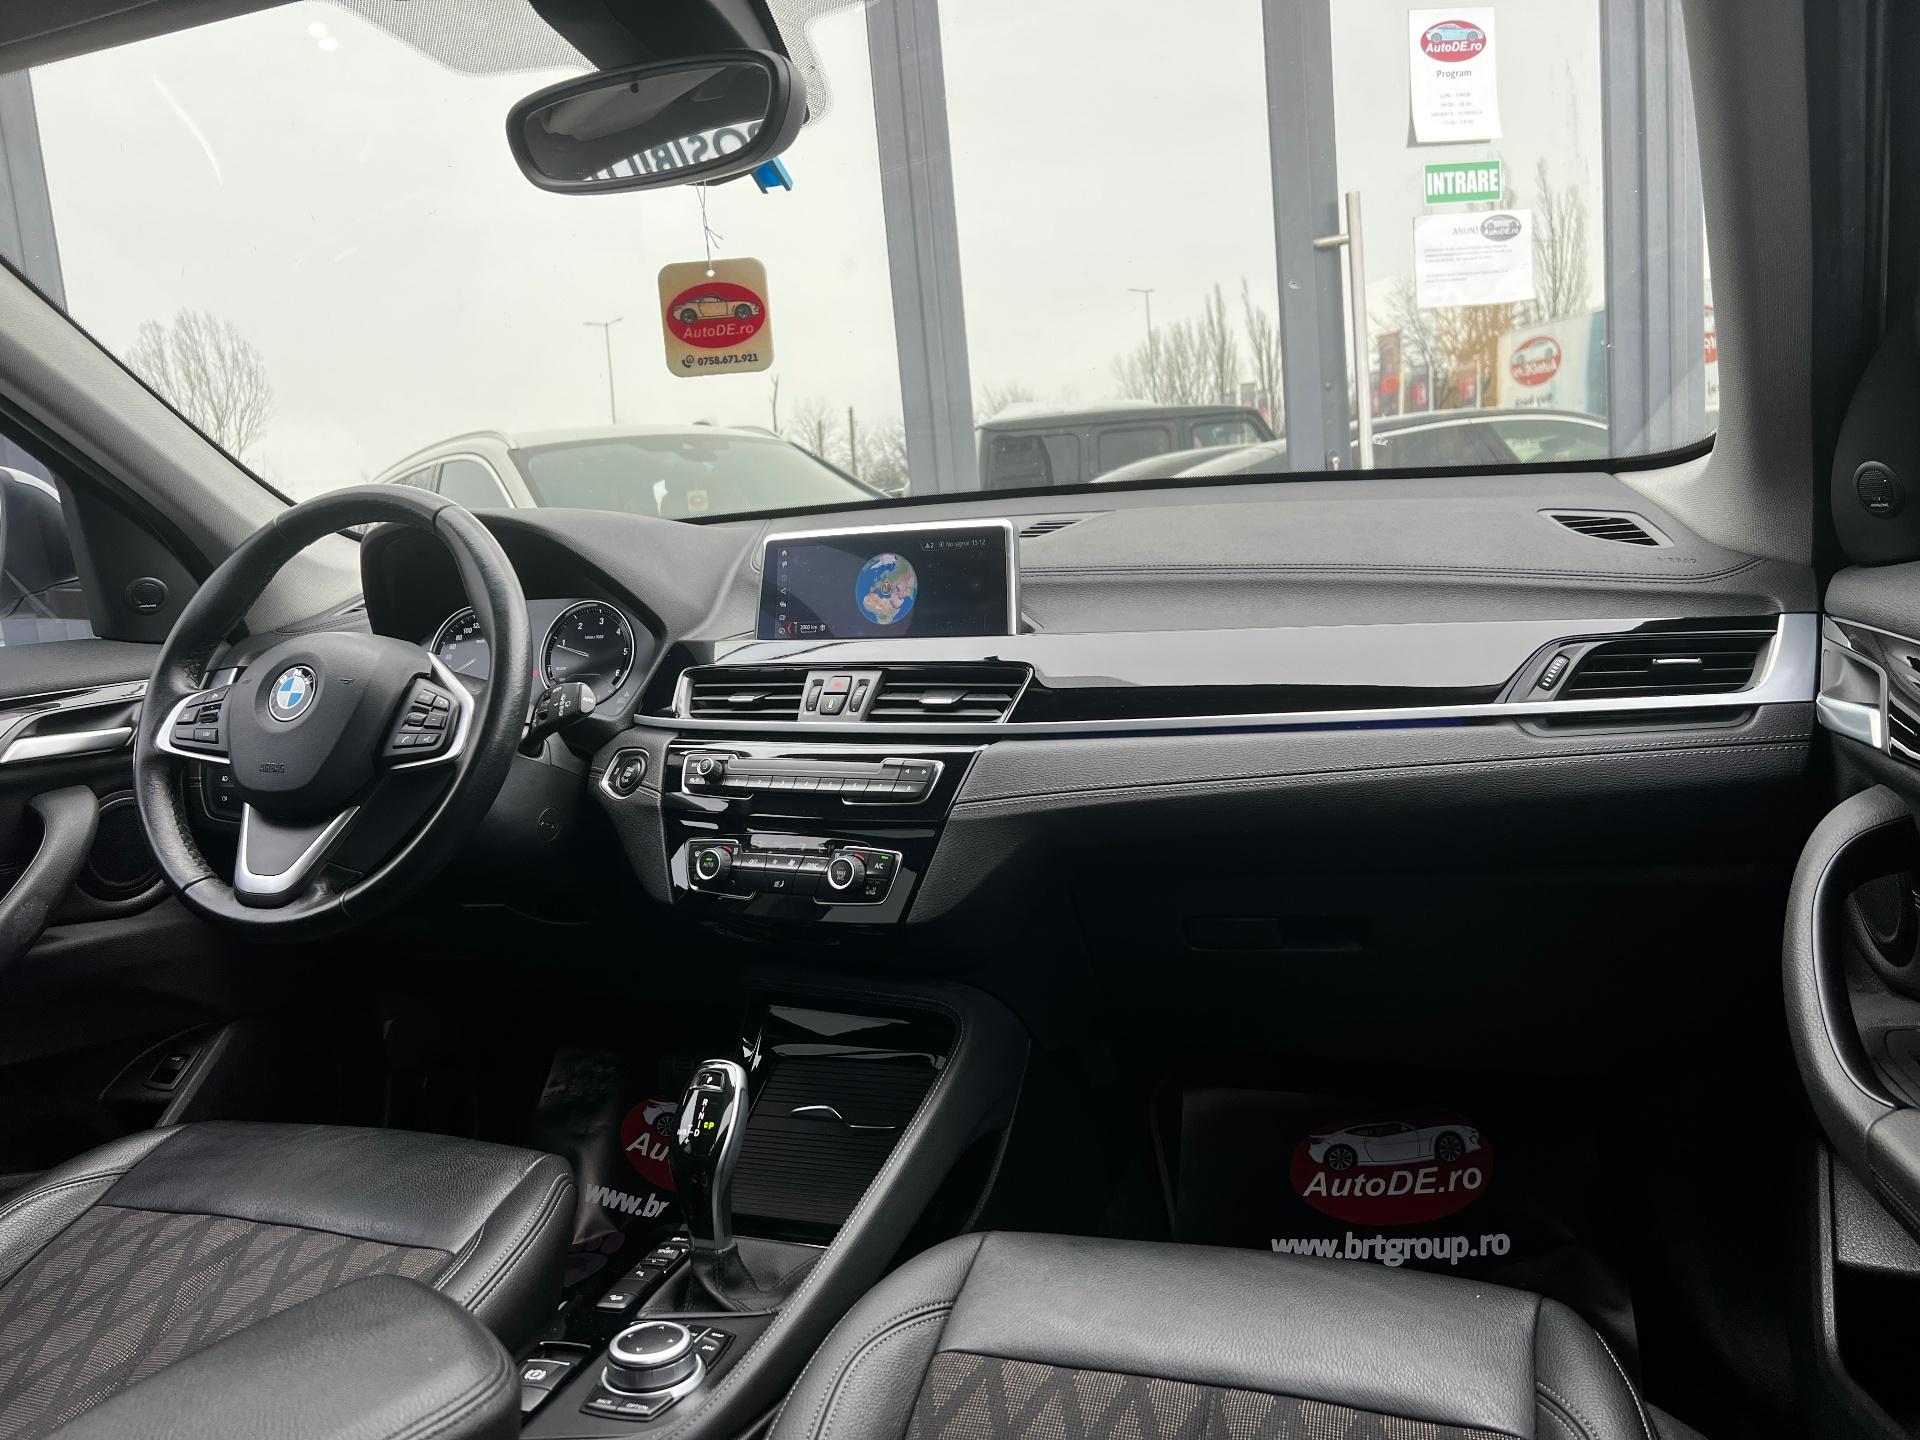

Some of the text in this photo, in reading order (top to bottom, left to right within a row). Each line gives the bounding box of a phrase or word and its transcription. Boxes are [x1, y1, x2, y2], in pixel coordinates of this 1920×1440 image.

[1425, 41, 1483, 53] AutoDE.ro
[1436, 70, 1472, 79] Program
[1427, 168, 1499, 196] INTRARE
[683, 324, 754, 339] AutoDE.ro
[698, 353, 759, 366] 0758.671.921
[463, 627, 473, 635] 100
[577, 622, 583, 630] 2
[623, 648, 628, 656] 5
[259, 762, 286, 773] AIRBAG
[698, 1112, 705, 1120] N
[693, 1128, 700, 1137] D
[625, 1132, 670, 1162] Au
[1302, 1166, 1482, 1197] AutoDE.ro
[585, 1183, 670, 1218] www.br
[1271, 1231, 1511, 1266] www.brtgroup.ro
